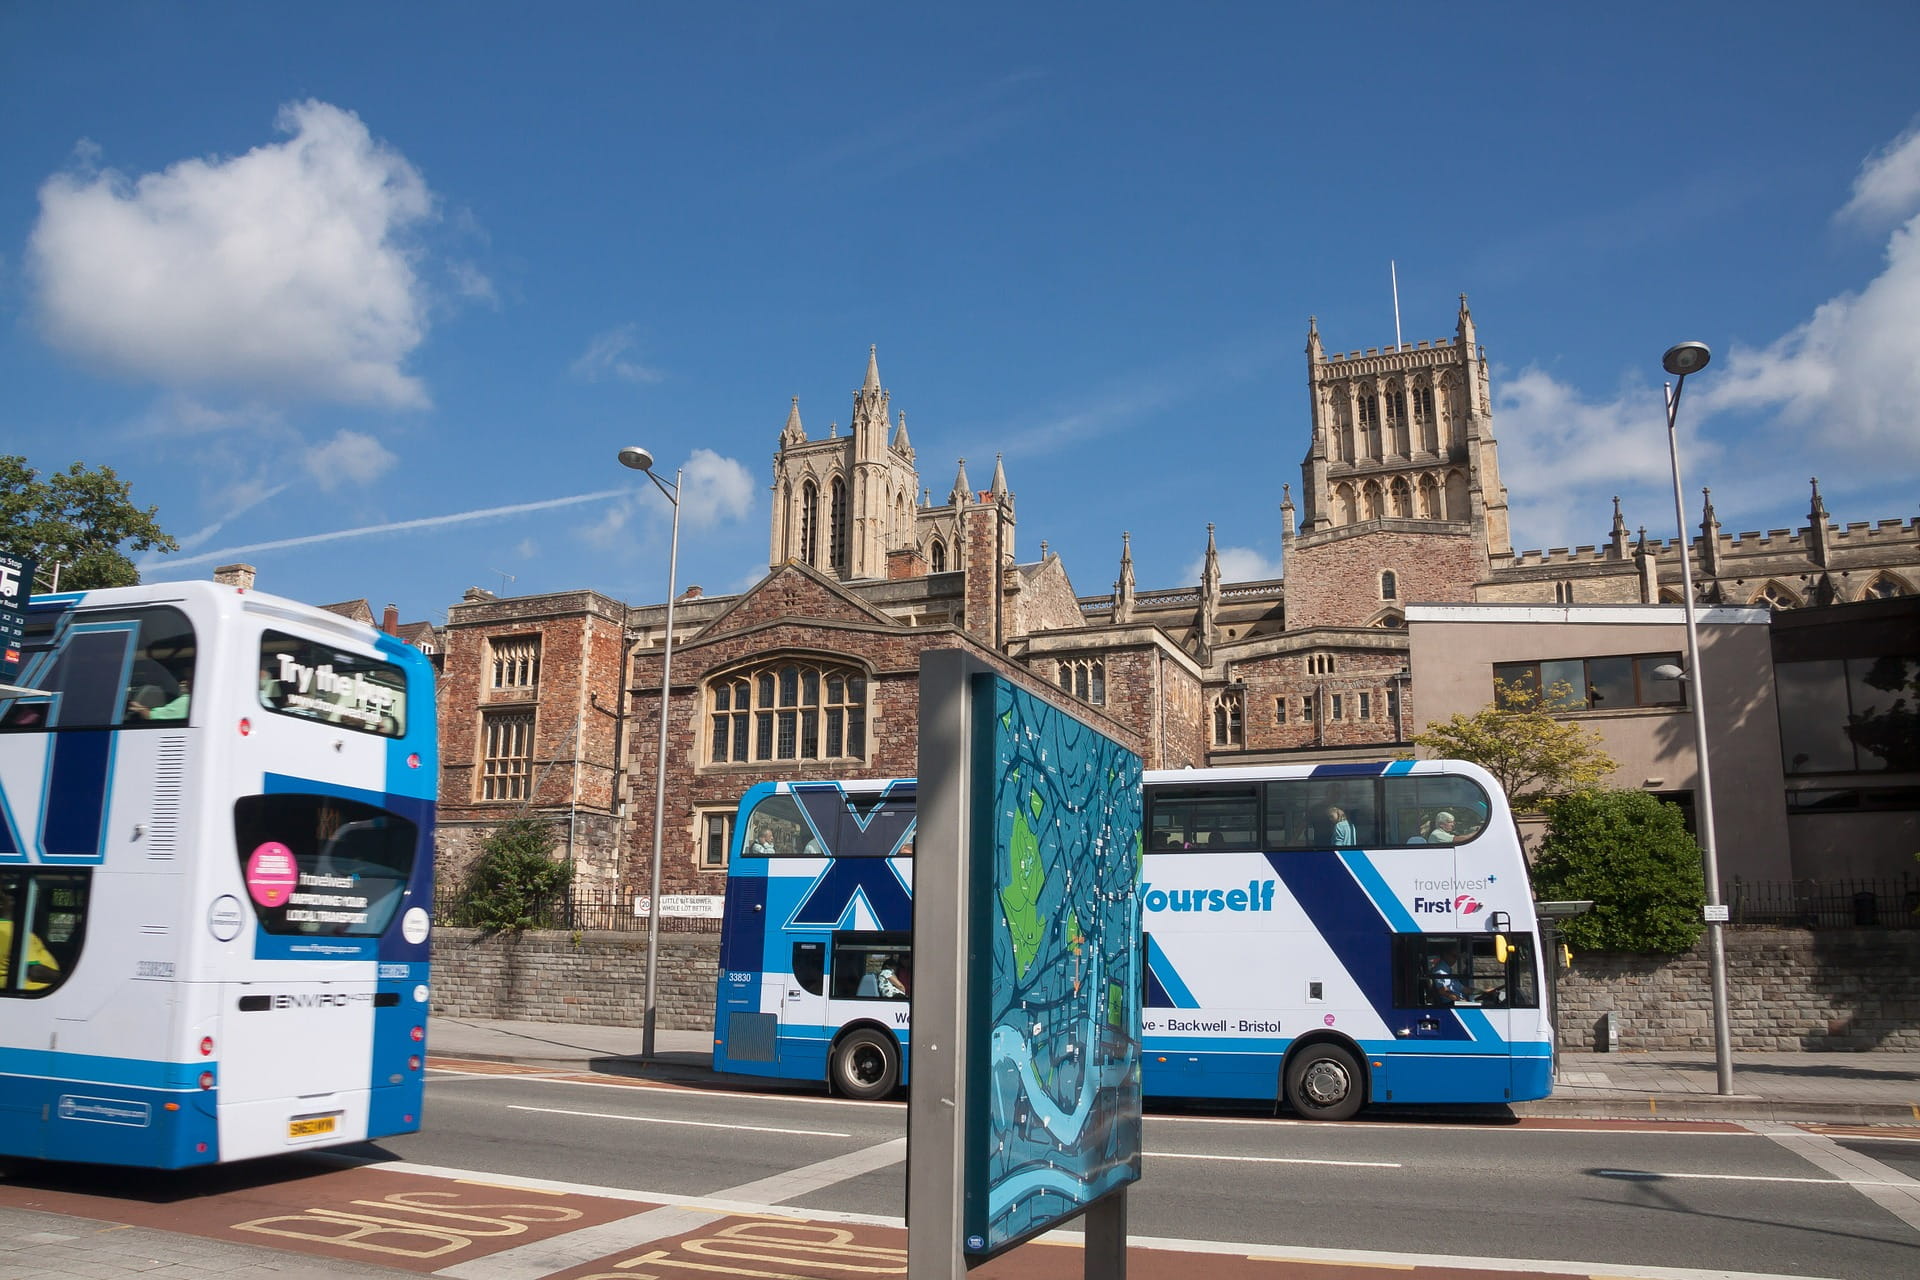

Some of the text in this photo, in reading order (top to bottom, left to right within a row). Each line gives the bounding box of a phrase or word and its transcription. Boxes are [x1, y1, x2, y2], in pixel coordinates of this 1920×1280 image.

[7, 557, 23, 569] Stop
[276, 653, 394, 706] Try the bus
[1414, 897, 1452, 913] First
[728, 972, 751, 982] 33830
[1167, 1019, 1227, 1032] Backwell
[1239, 1020, 1281, 1033] Bristol
[229, 1191, 583, 1259] BUS
[575, 1221, 908, 1280] TOP
